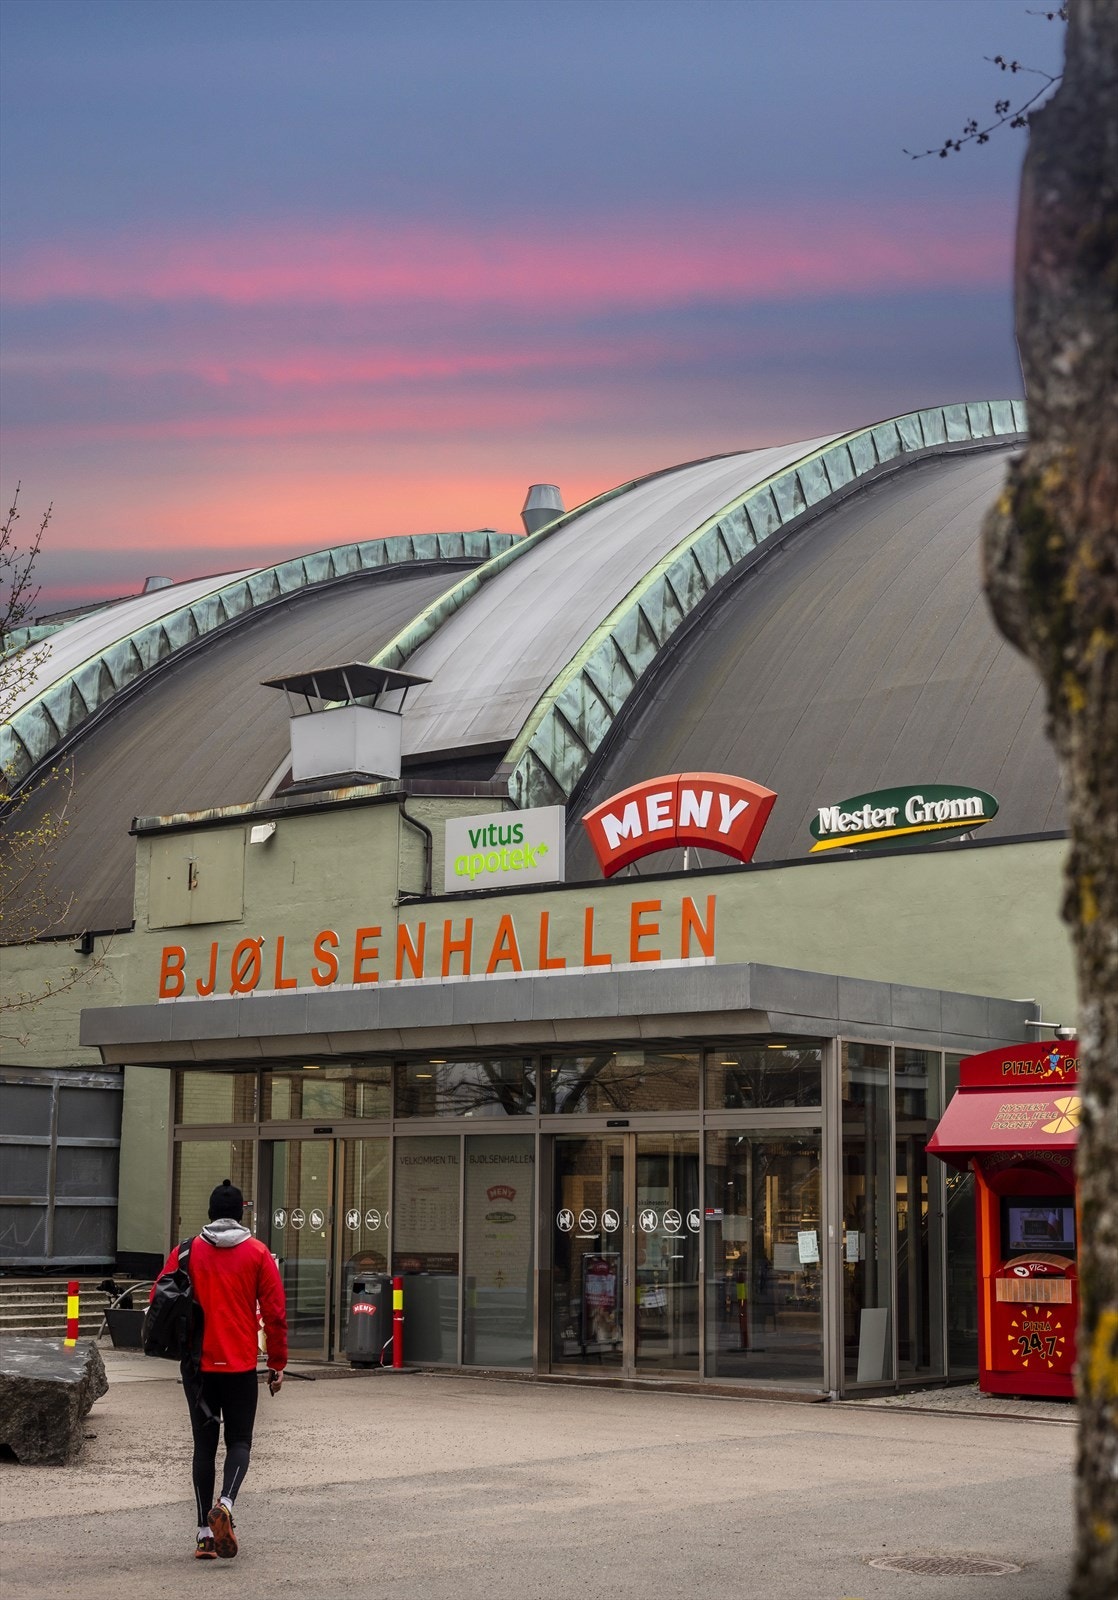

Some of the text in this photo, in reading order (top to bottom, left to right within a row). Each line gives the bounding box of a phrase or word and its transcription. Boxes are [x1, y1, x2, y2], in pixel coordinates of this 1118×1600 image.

[600, 789, 750, 851] MENY
[817, 793, 985, 834] Mester Grønn
[468, 822, 524, 849] vitus
[157, 894, 718, 999] BJØLSENHALLEN
[1001, 1060, 1045, 1076] PIZZA
[400, 1154, 536, 1166] VELKOMMEN TIL BJØLSENHALLEN
[489, 1187, 514, 1198] MENY
[354, 1304, 374, 1312] MENY
[1023, 1321, 1052, 1332] PIZZA
